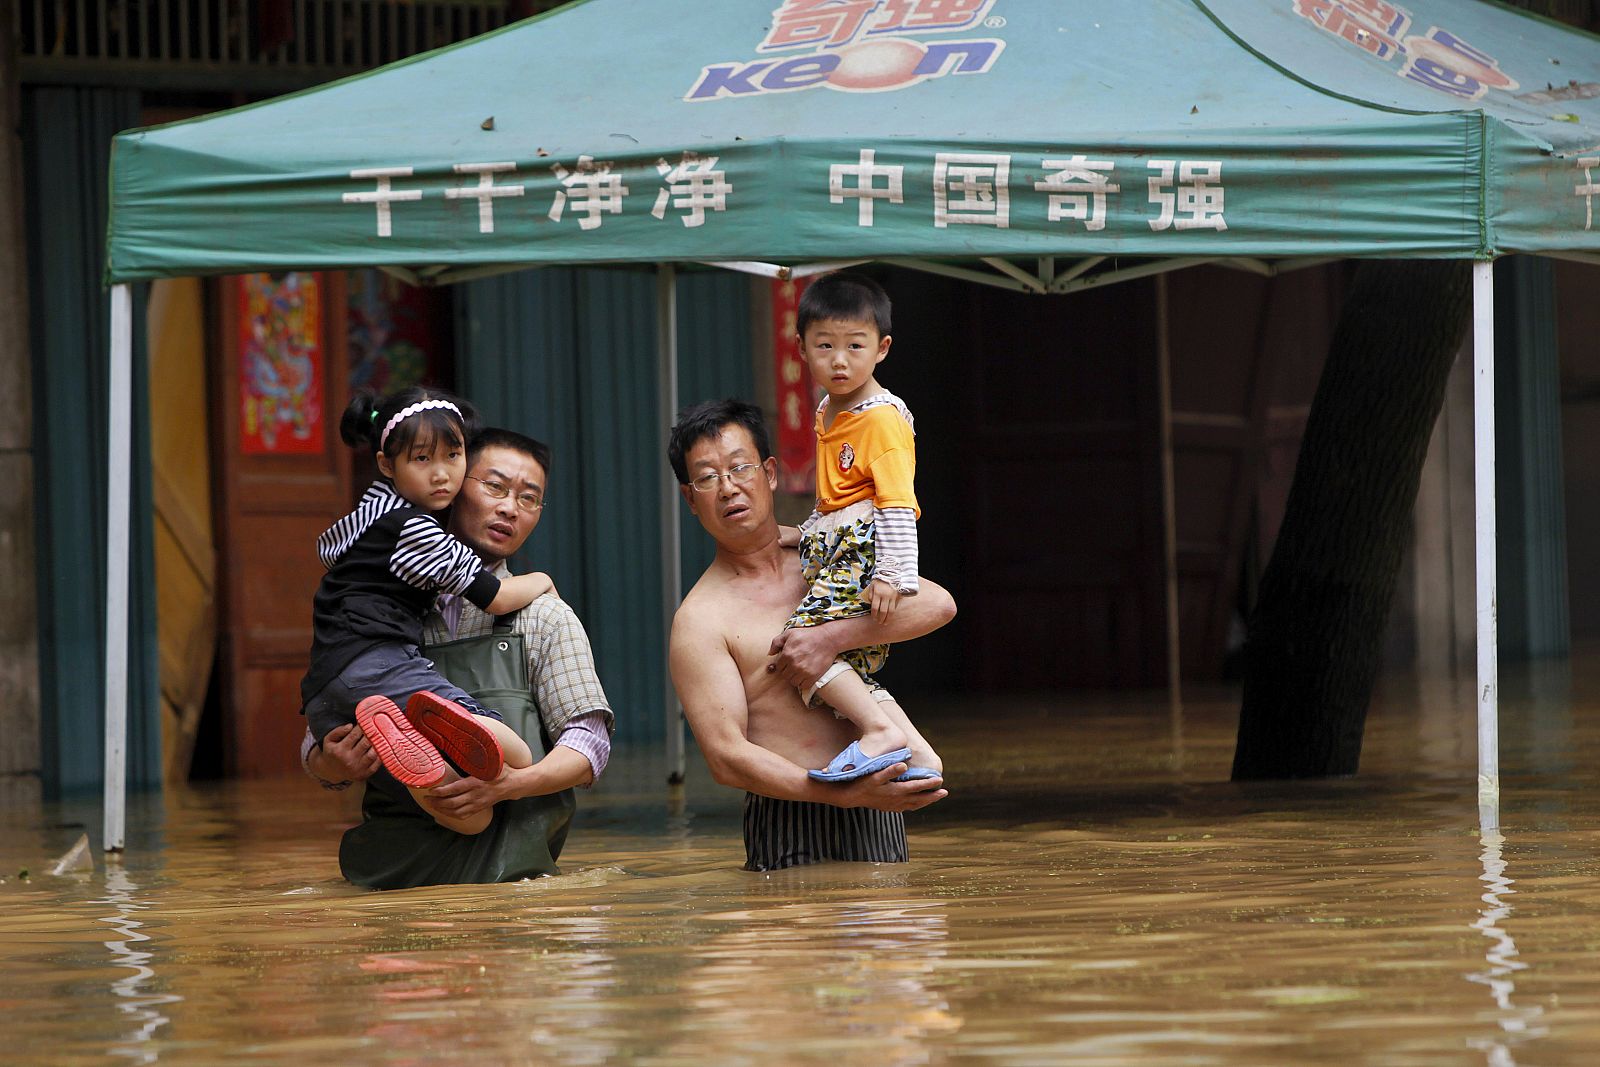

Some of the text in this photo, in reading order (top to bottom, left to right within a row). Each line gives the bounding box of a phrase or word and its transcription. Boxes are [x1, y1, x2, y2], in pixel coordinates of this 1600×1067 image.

[342, 149, 1228, 237] 干干净净 中国奇强
